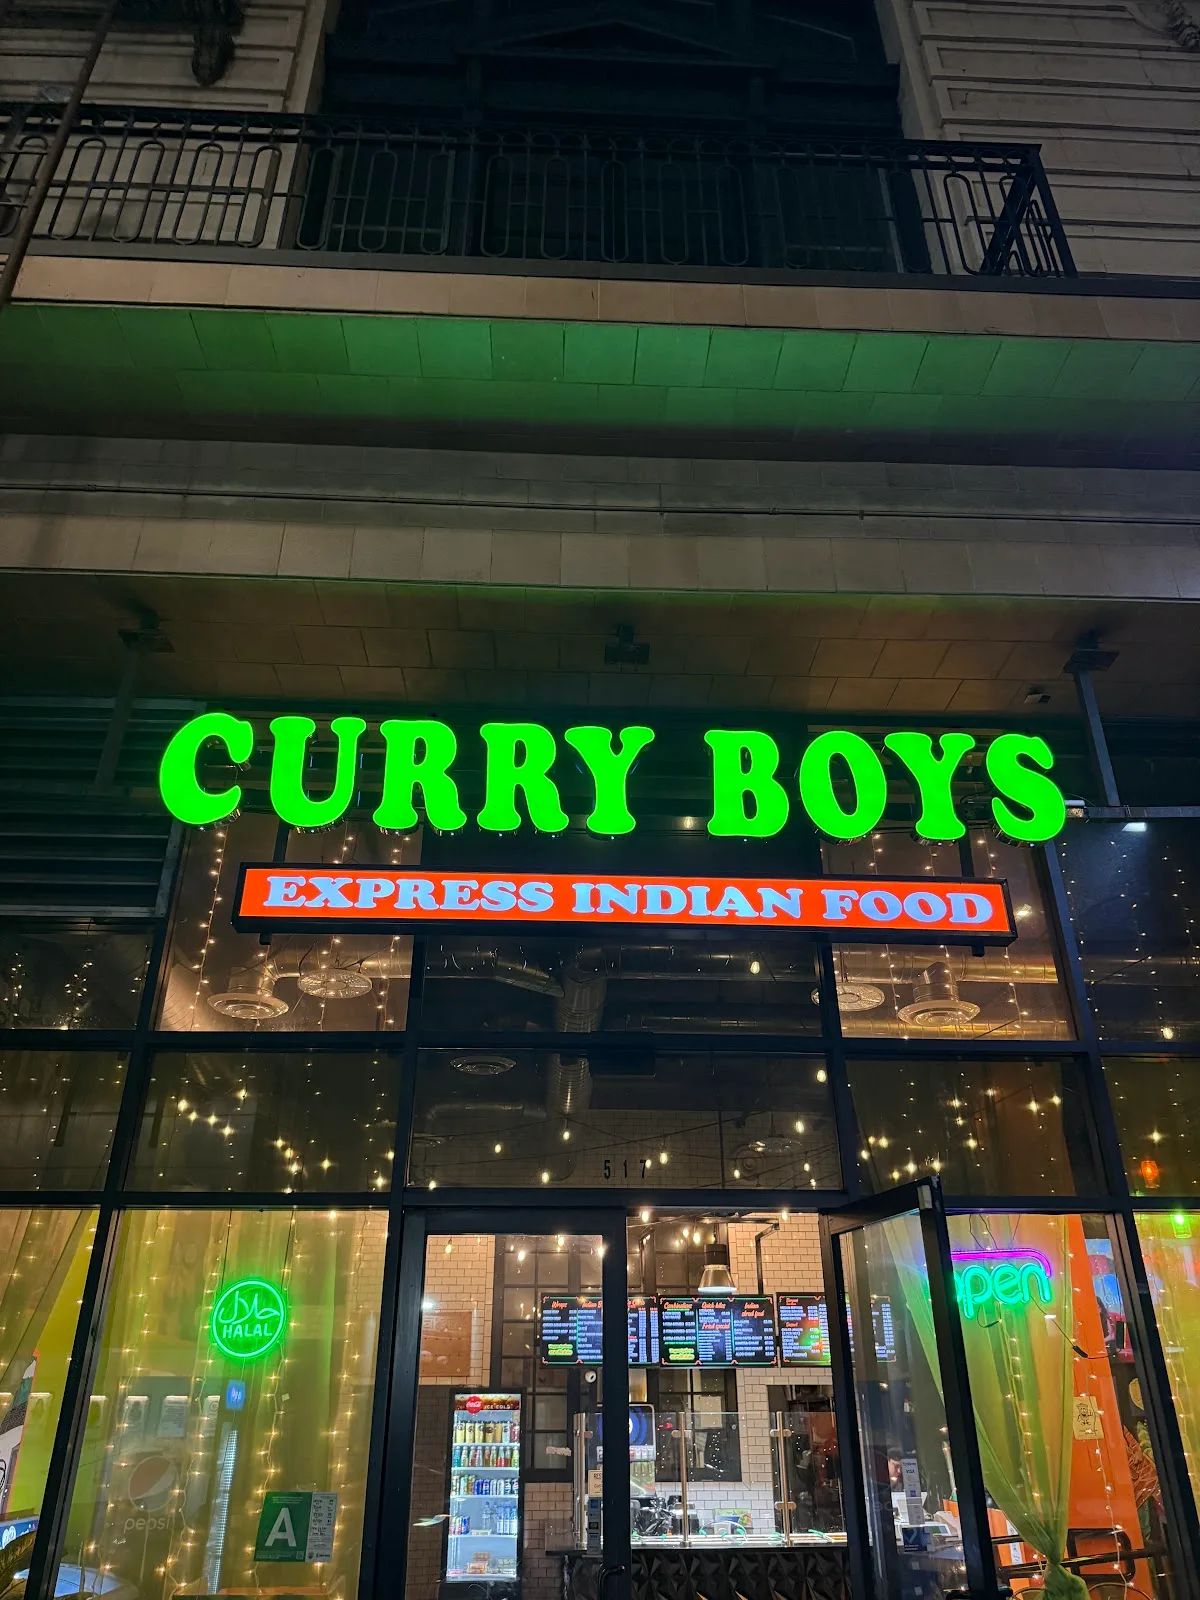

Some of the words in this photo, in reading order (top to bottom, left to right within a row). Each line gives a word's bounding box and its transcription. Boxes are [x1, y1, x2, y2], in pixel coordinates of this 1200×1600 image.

[159, 712, 655, 836] CURRY
[703, 729, 1066, 842] BOYS
[263, 876, 554, 912] EXPRESS
[571, 883, 803, 918] INDIAN
[822, 889, 992, 923] FOOD
[604, 1160, 646, 1179] 517
[218, 1290, 281, 1325] حلال
[222, 1323, 273, 1339] HALAL
[123, 1517, 170, 1534] pepsi
[264, 1507, 297, 1547] A
